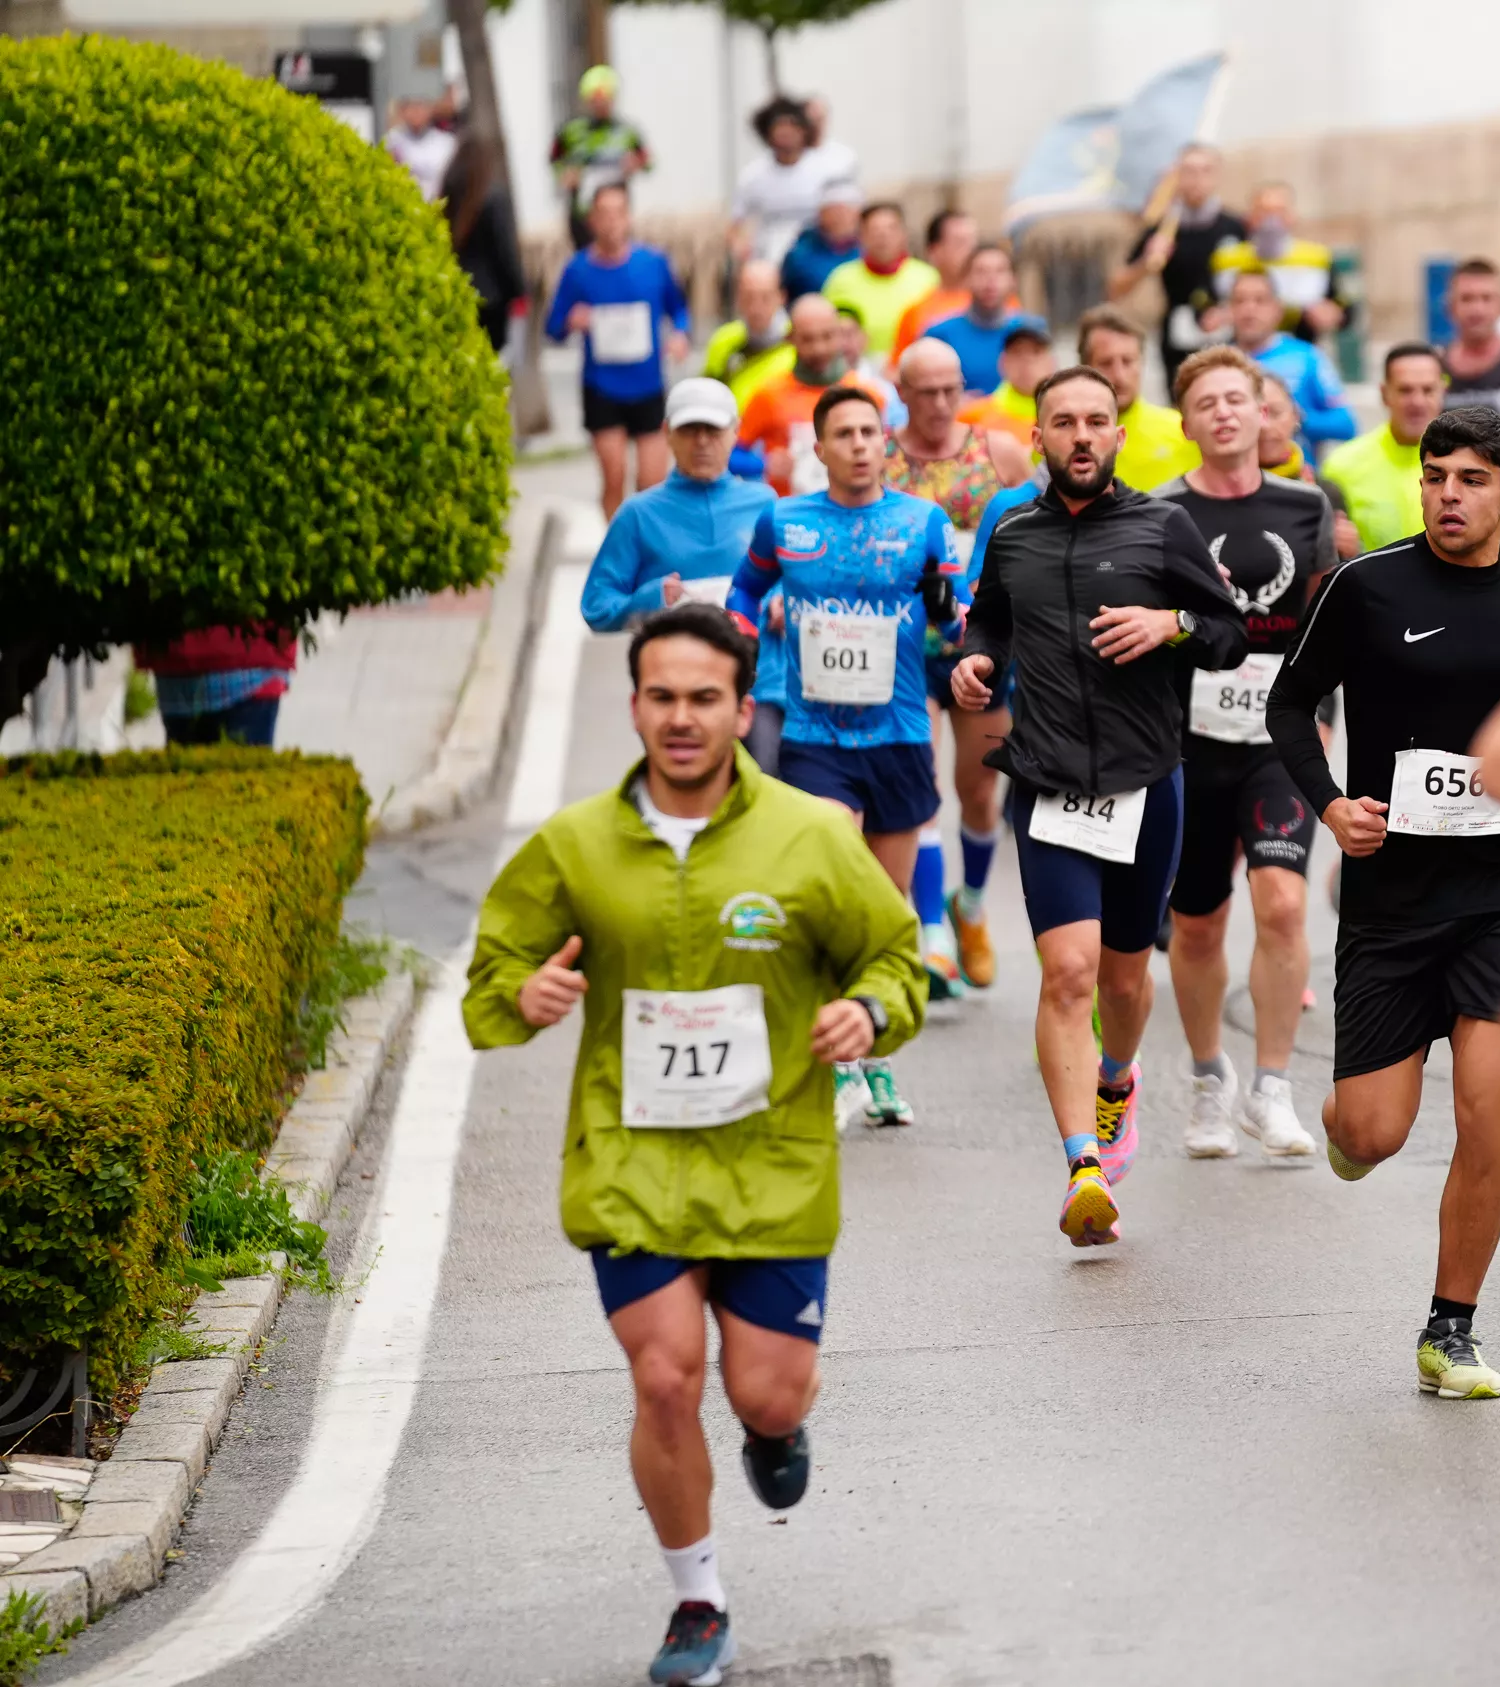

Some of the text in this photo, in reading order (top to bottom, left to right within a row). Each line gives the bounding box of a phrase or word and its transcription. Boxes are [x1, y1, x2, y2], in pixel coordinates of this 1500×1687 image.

[822, 646, 871, 671] 601
[1219, 686, 1268, 712] 845
[1424, 765, 1486, 798] 656
[1063, 790, 1116, 823] 814
[658, 1041, 730, 1077] 717
